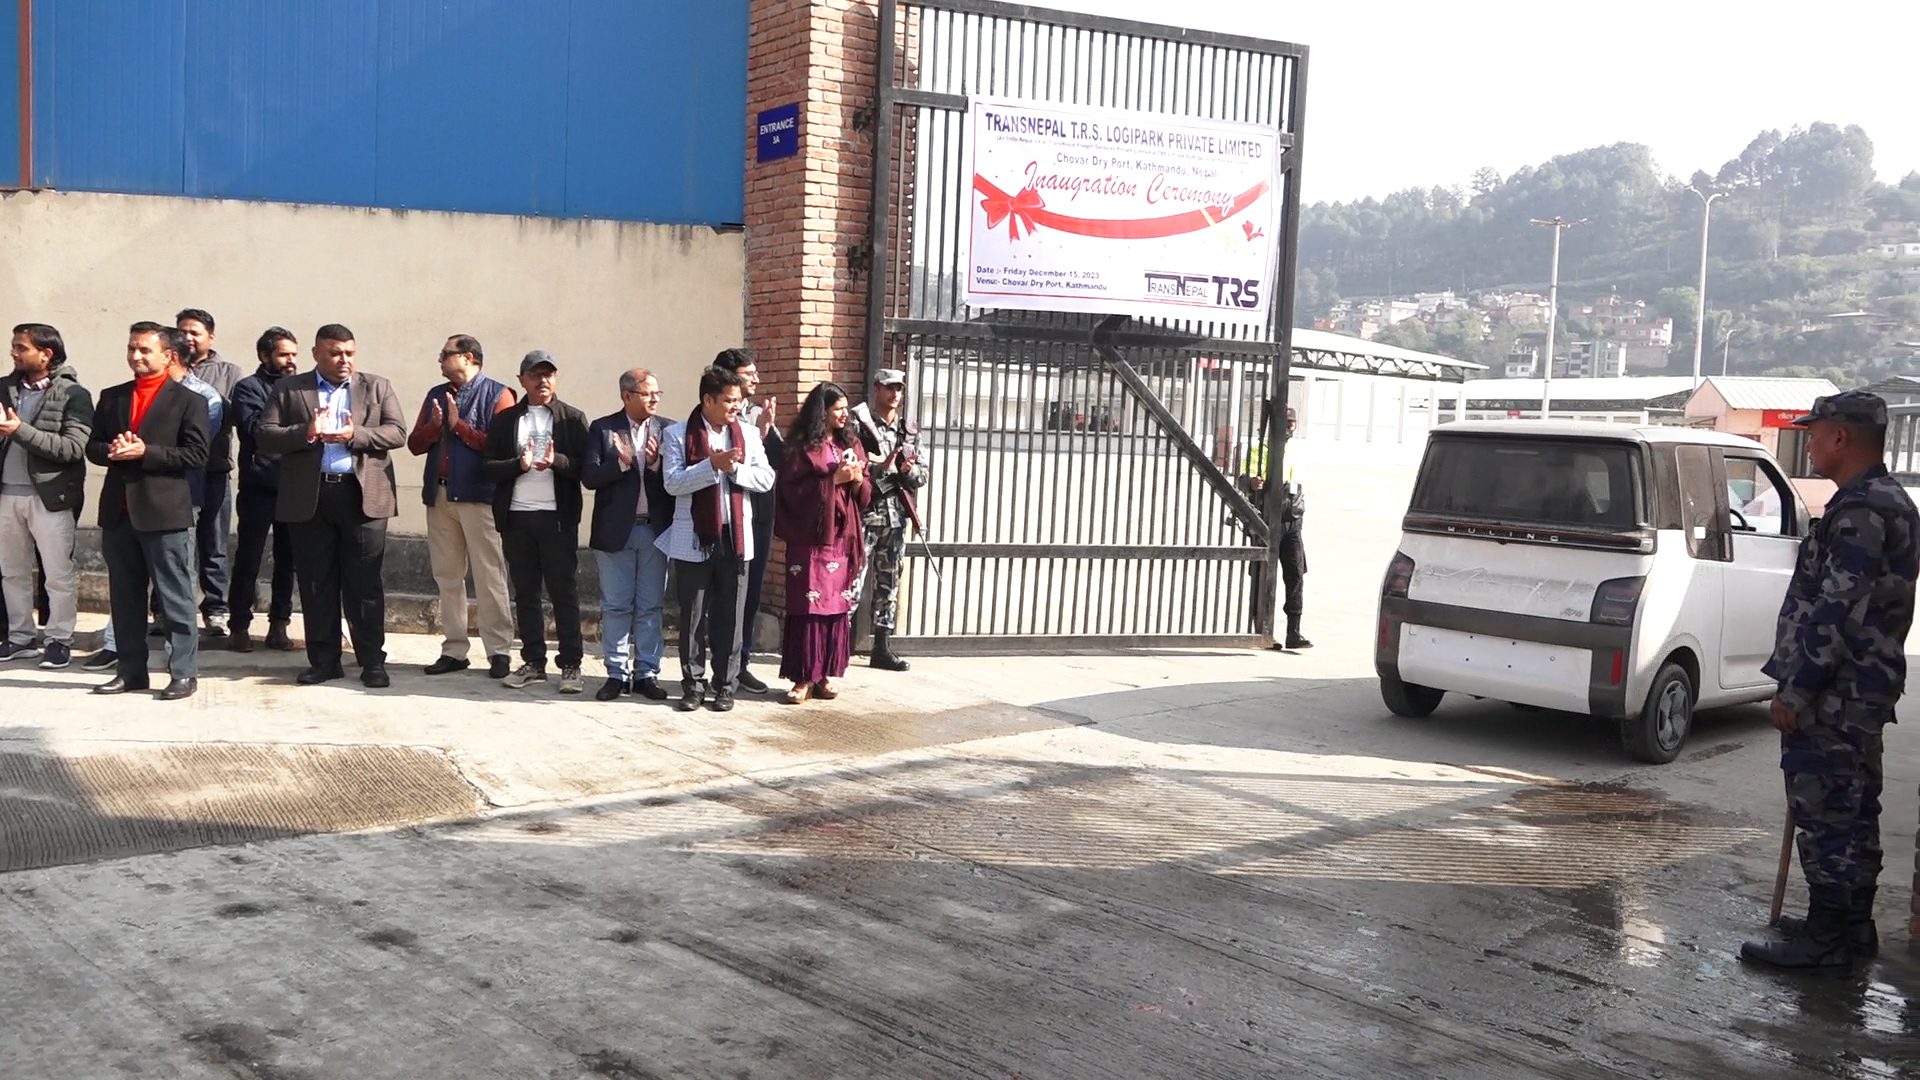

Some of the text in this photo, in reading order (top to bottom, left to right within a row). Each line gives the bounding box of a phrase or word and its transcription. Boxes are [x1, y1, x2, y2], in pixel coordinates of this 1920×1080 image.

[760, 117, 794, 135] ENTRANCE
[772, 135, 780, 144] 3A
[985, 112, 1066, 138] TRANSNEPAL
[1071, 121, 1102, 141] T.R.S.
[1107, 125, 1164, 148] LOGIPARK
[1168, 132, 1214, 154] PRIVATE
[1219, 138, 1262, 159] LIMITED
[1056, 152, 1217, 180] Chovar Dry Port, Kathmandu, Nepal
[1024, 160, 1234, 214] Inaugration Ceremony
[976, 265, 995, 274] Date
[1003, 266, 1027, 277] Friday
[1029, 268, 1066, 278] December
[1082, 271, 1100, 280] 2023
[1002, 277, 1028, 287] Chovar
[1030, 279, 1044, 289] Dry
[1065, 281, 1108, 291] Kathmandu
[1212, 275, 1260, 308] TRS
[1447, 525, 1559, 542] WULING
